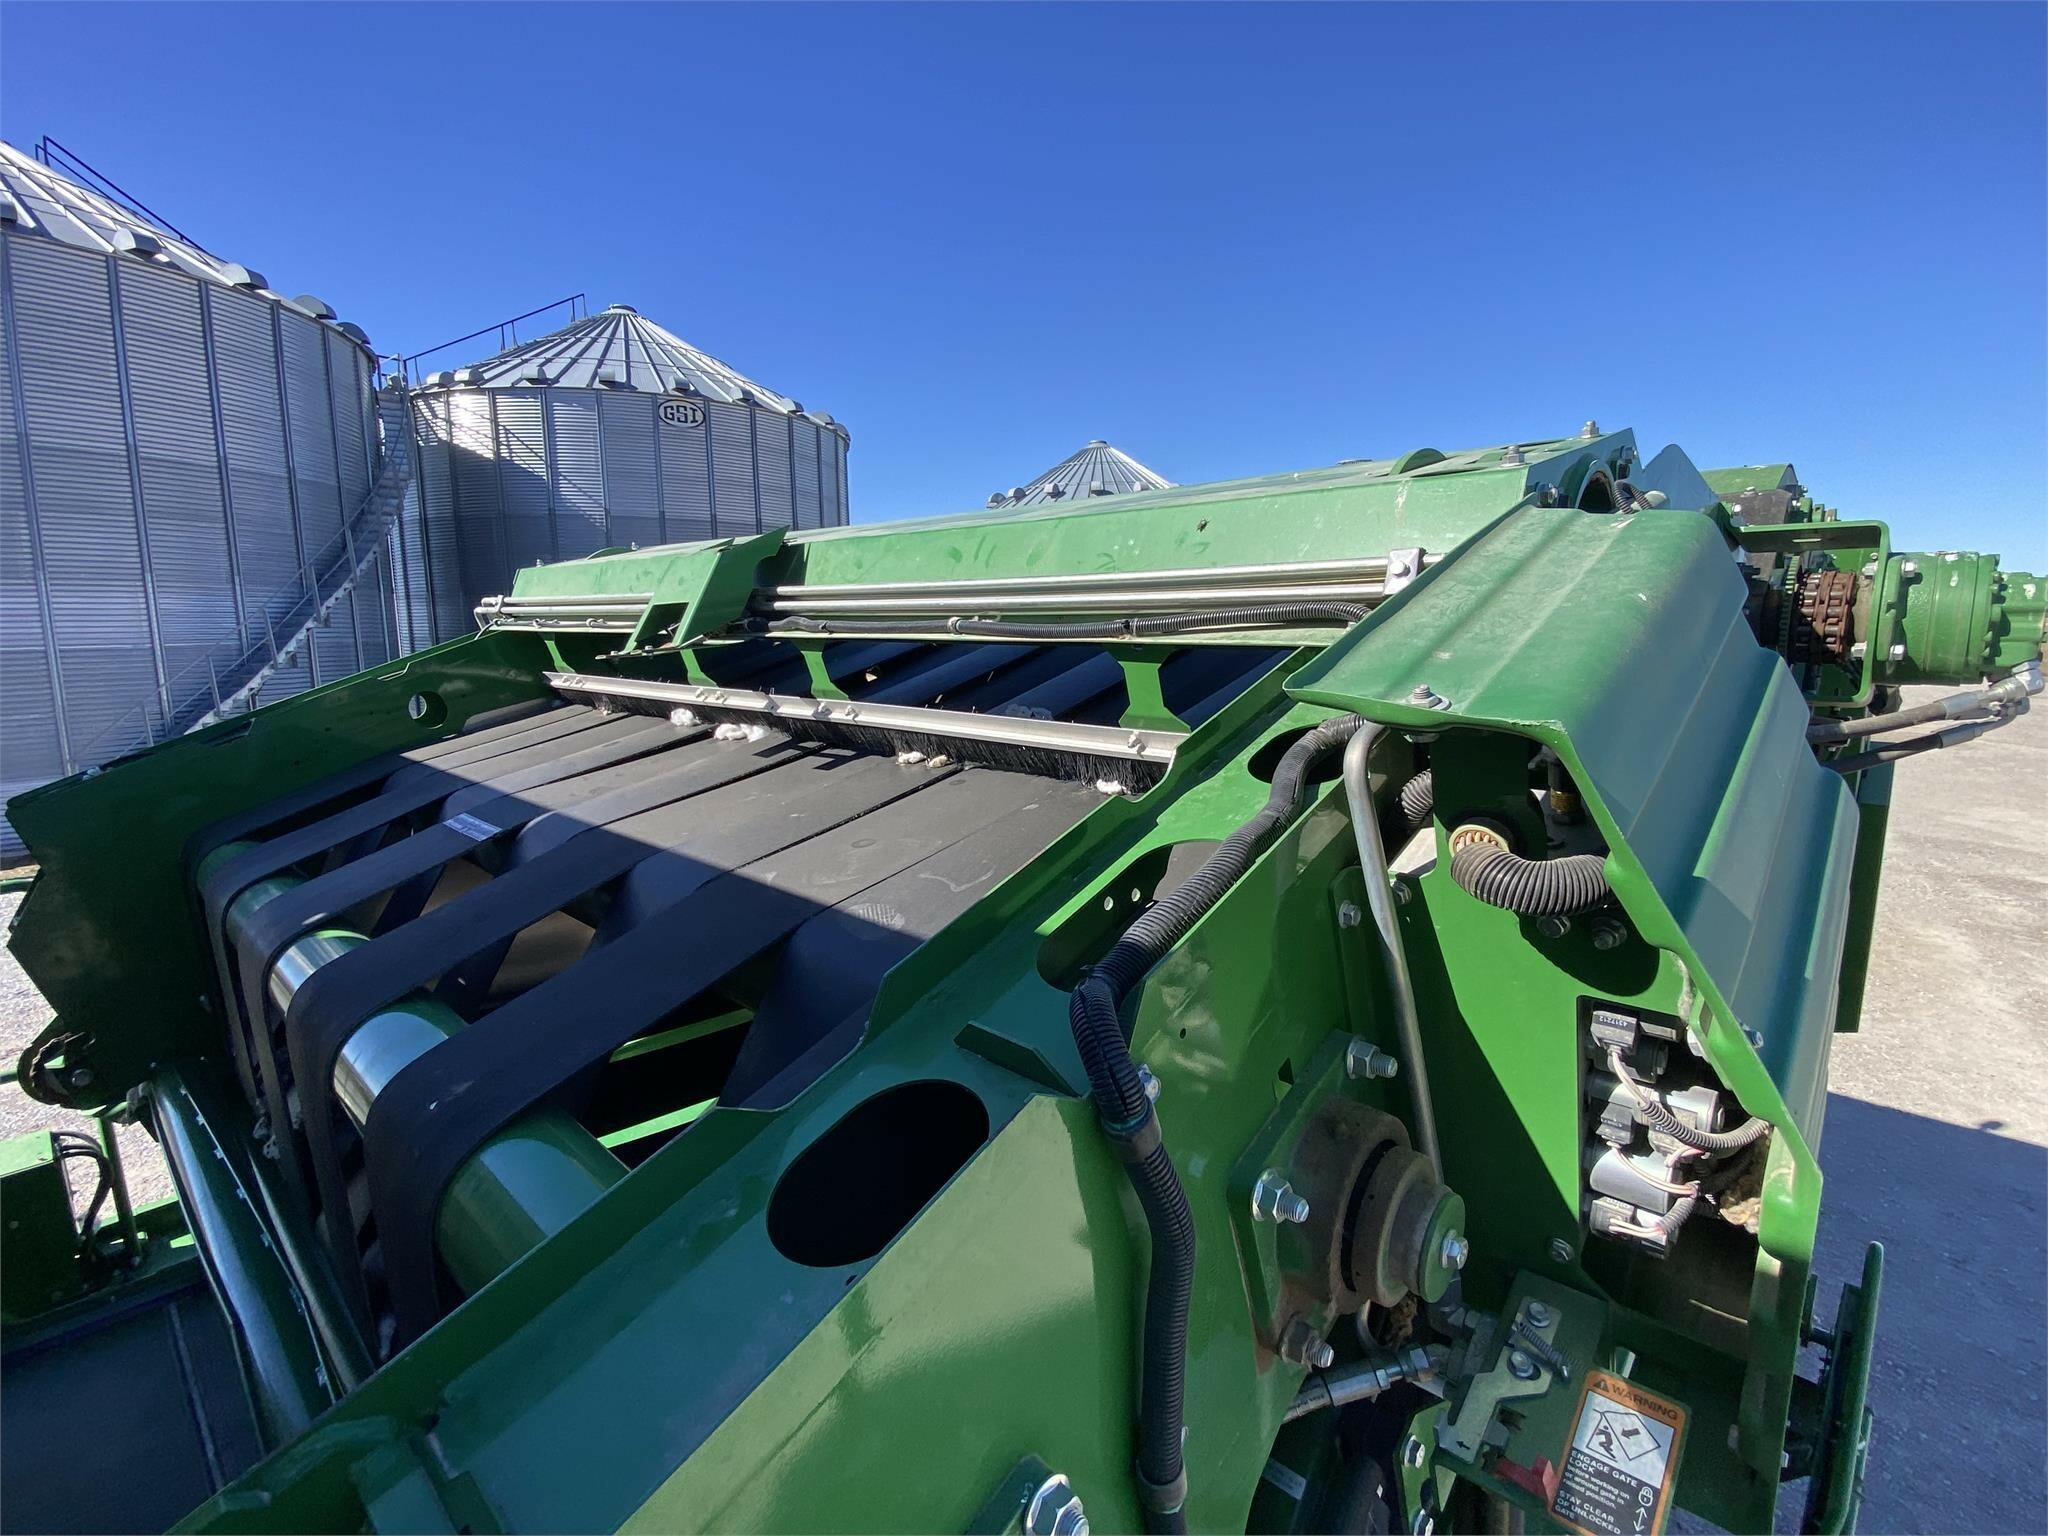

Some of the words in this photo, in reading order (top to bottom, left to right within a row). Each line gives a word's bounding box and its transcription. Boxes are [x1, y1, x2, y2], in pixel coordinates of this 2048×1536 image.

[664, 405, 698, 424] GSI
[1612, 1384, 1678, 1420] WARNING
[1569, 1458, 1595, 1473] LOCK
[1571, 1451, 1610, 1473] ENGAGE
[1612, 1470, 1638, 1488] GATE
[1563, 1479, 1584, 1493] raised
[1567, 1465, 1589, 1479] before
[1591, 1476, 1619, 1494] working
[1620, 1491, 1630, 1500] on
[1574, 1475, 1599, 1492] around
[1599, 1486, 1616, 1500] gate
[1617, 1495, 1624, 1504] in
[1555, 1505, 1575, 1519] GATE
[1557, 1499, 1569, 1508] OF
[1571, 1505, 1621, 1534] UNLOCKED
[1559, 1490, 1582, 1505] STAY
[1583, 1503, 1614, 1522] CLEAR
